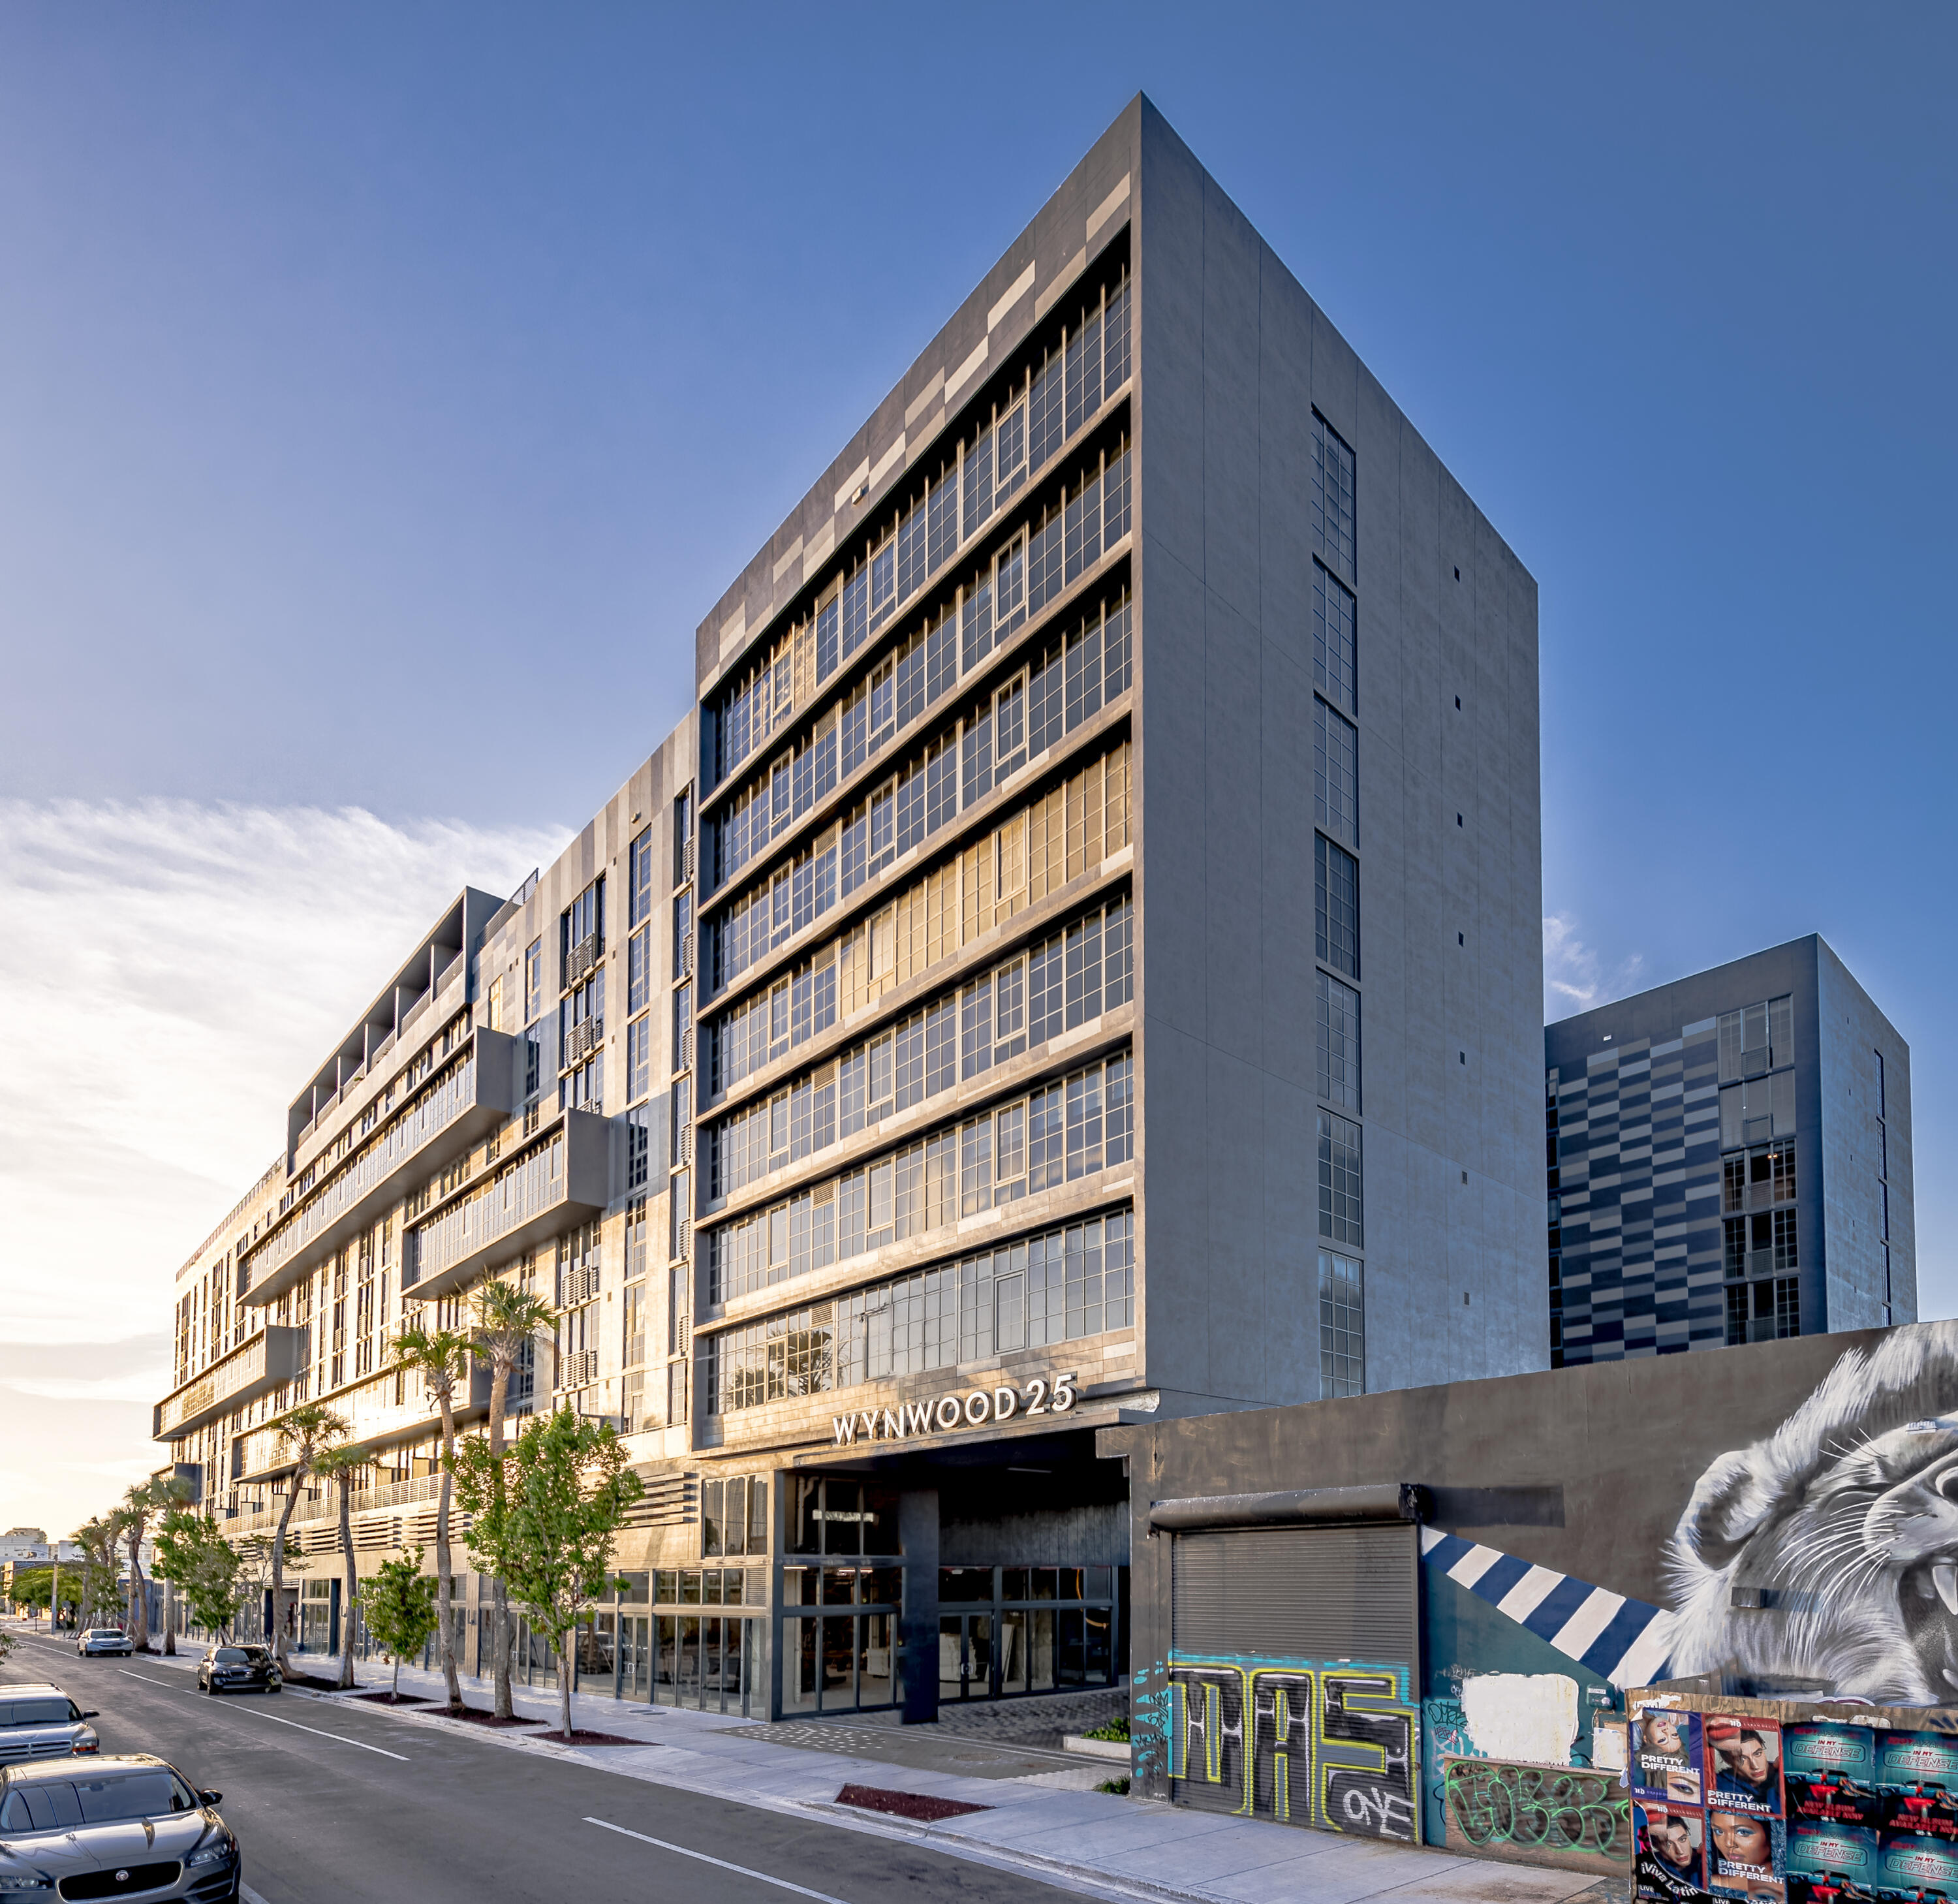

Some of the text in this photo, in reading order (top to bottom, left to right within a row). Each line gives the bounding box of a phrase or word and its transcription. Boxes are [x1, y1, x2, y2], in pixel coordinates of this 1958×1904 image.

[833, 1373, 1076, 1444] WYNWOOD 25
[1795, 1743, 1861, 1758] DEFENSE
[1641, 1754, 1683, 1766] PRETTY
[1641, 1761, 1700, 1775] DIFFERENT
[1888, 1754, 1958, 1770] DEFENSE
[1707, 1789, 1754, 1802] PRETTY
[1707, 1797, 1771, 1813] DIFFERENT
[1797, 1843, 1863, 1860] DEFENSE
[1718, 1858, 1765, 1873] PRETTY
[1890, 1858, 1958, 1879] DEFENSE
[1718, 1867, 1784, 1884] DIFFERENT
